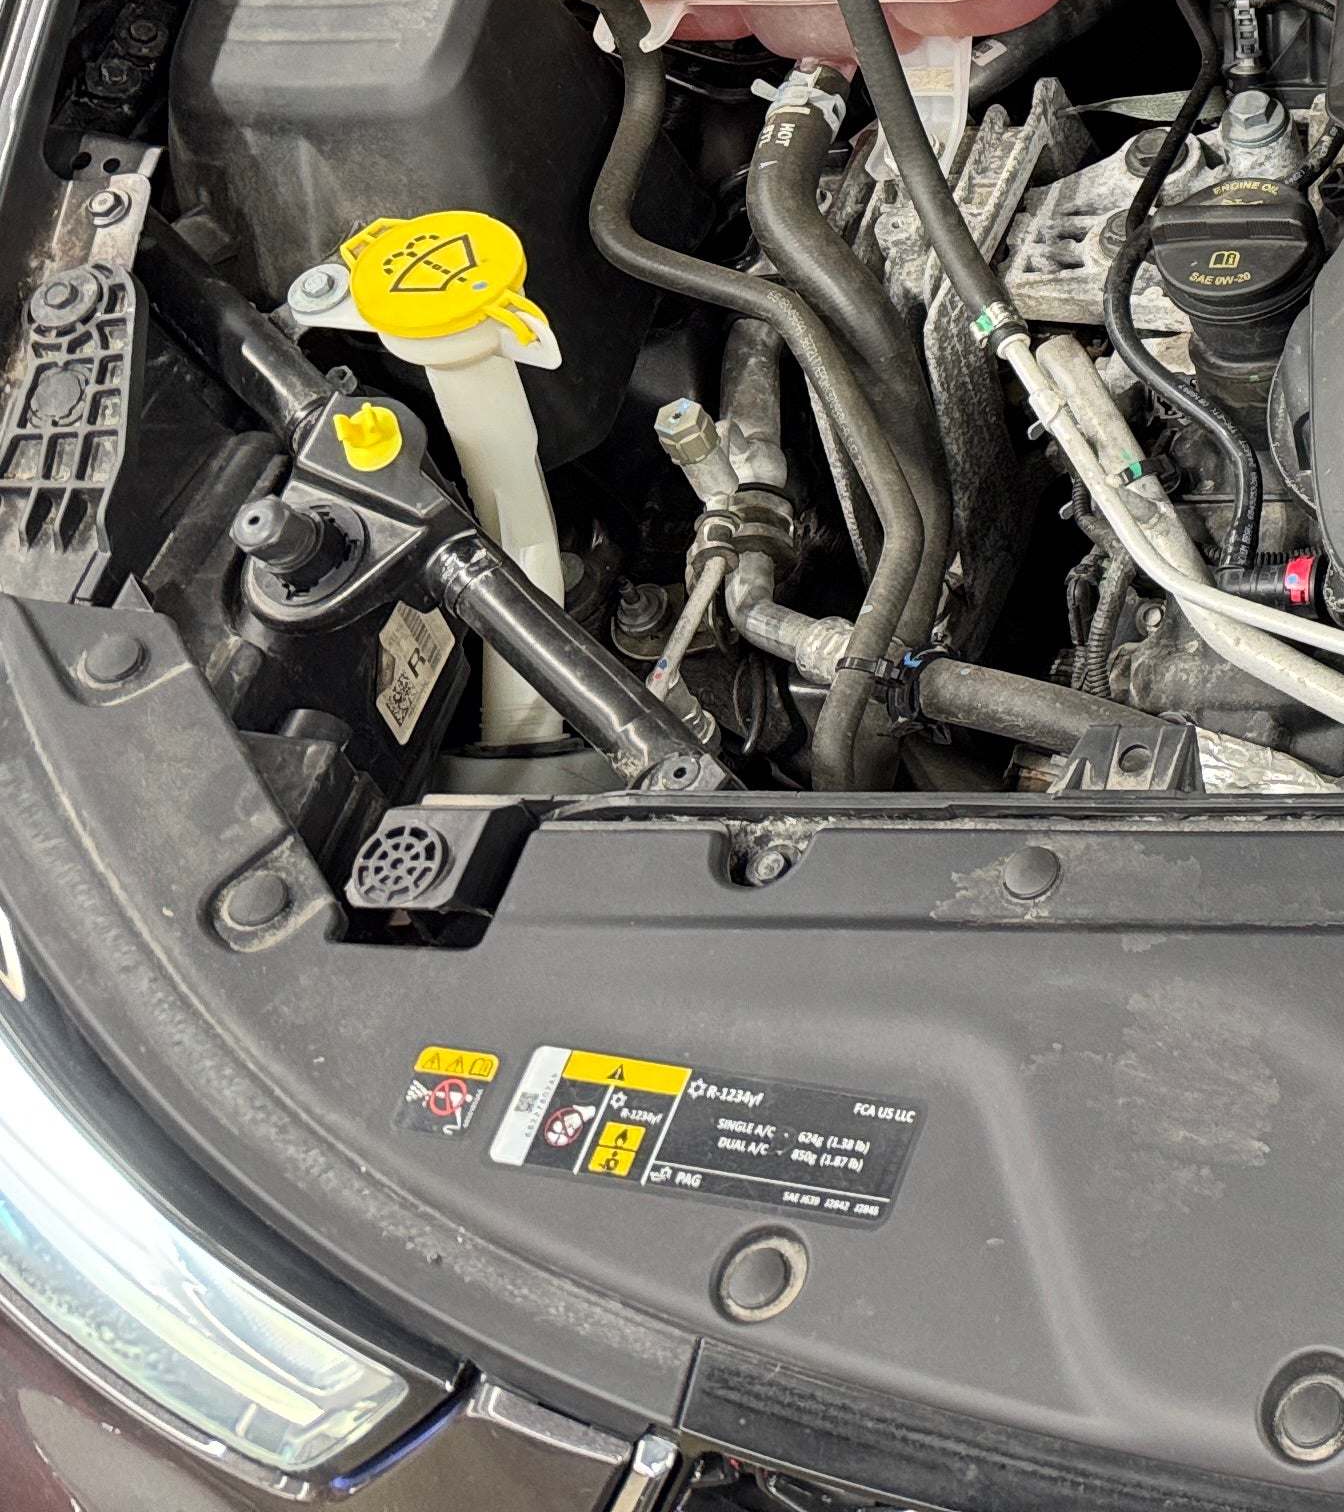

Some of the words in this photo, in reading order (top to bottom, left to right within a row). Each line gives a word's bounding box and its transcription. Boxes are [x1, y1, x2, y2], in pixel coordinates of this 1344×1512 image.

[775, 123, 795, 147] HOT
[1213, 181, 1260, 195] ENGINE
[1261, 181, 1280, 196] OIL
[1189, 272, 1213, 285] SAE
[1214, 272, 1251, 285] 0W-20
[408, 648, 428, 679] R
[706, 1085, 765, 1108] R-1234yf
[620, 1108, 664, 1126] R-1234yf
[853, 1102, 876, 1119] FCA
[877, 1106, 894, 1120] US
[894, 1108, 917, 1124] LLC
[717, 1118, 755, 1135] SINGLE
[754, 1123, 777, 1138] A/C
[797, 1132, 825, 1148] 624g
[826, 1134, 854, 1151] (1.38
[854, 1138, 871, 1155] lb)
[717, 1136, 747, 1152] DUAL
[747, 1140, 770, 1156] A/C
[790, 1148, 817, 1166] 850g
[819, 1153, 848, 1168] (1.87
[847, 1156, 864, 1173] lb)
[675, 1170, 703, 1189] PAG
[782, 1191, 800, 1203] SAE
